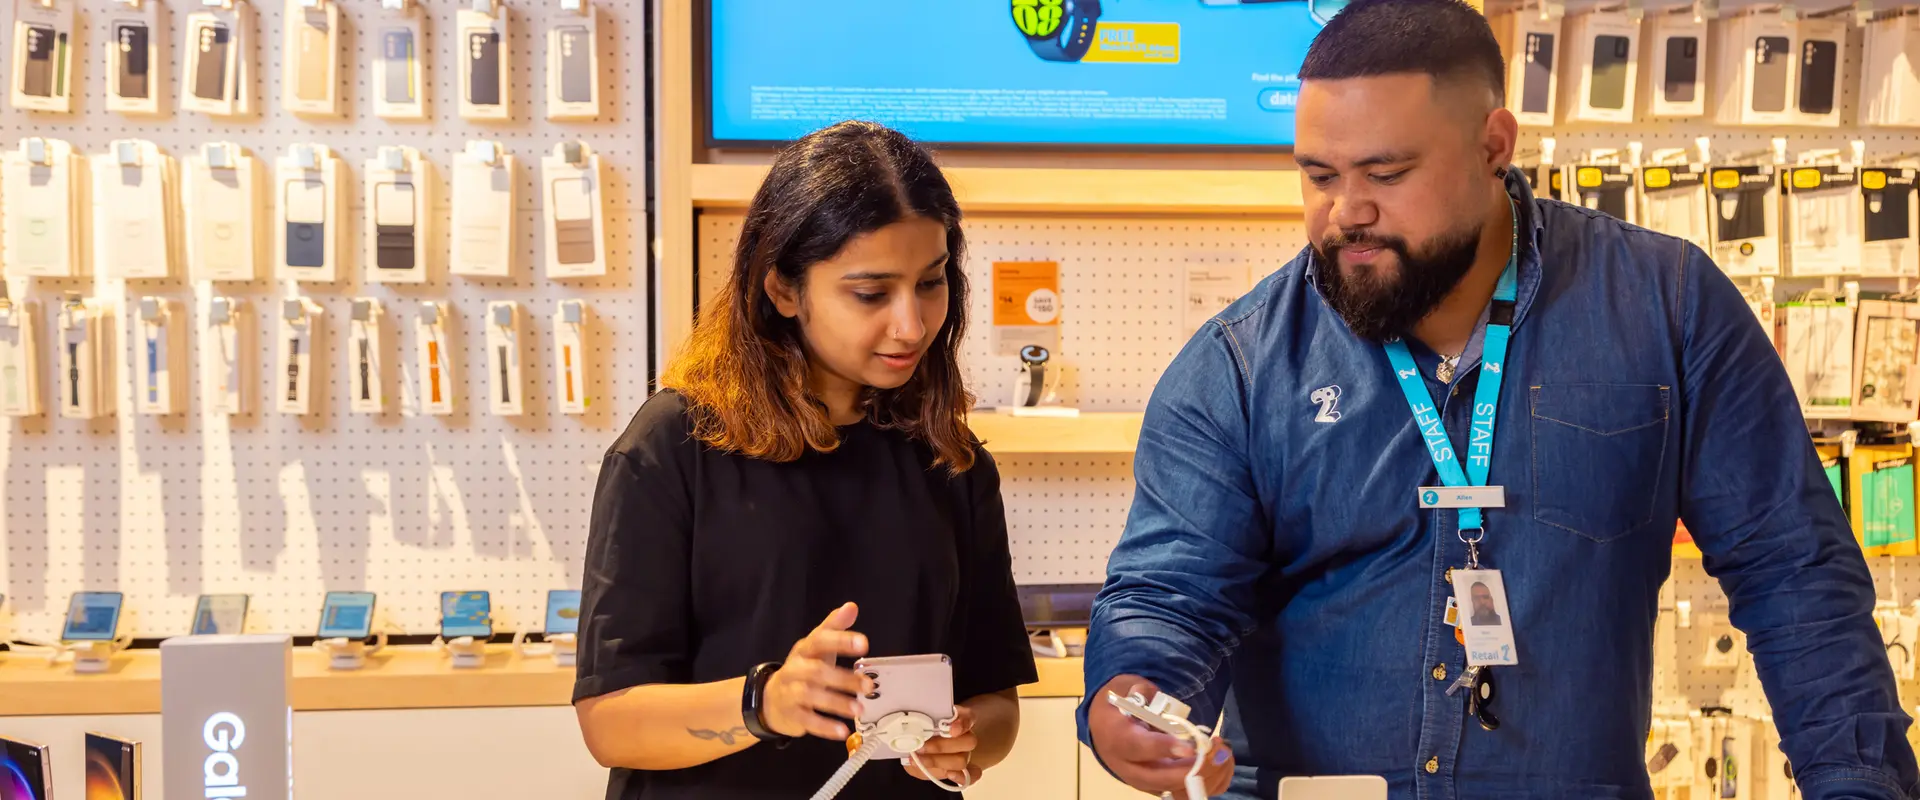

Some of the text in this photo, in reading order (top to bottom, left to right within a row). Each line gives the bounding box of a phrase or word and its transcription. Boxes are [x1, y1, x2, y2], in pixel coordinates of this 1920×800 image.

[1412, 402, 1453, 463] STAFF
[1470, 402, 1495, 467] STAFF
[1472, 651, 1499, 661] Retail
[203, 711, 247, 800] Gal
